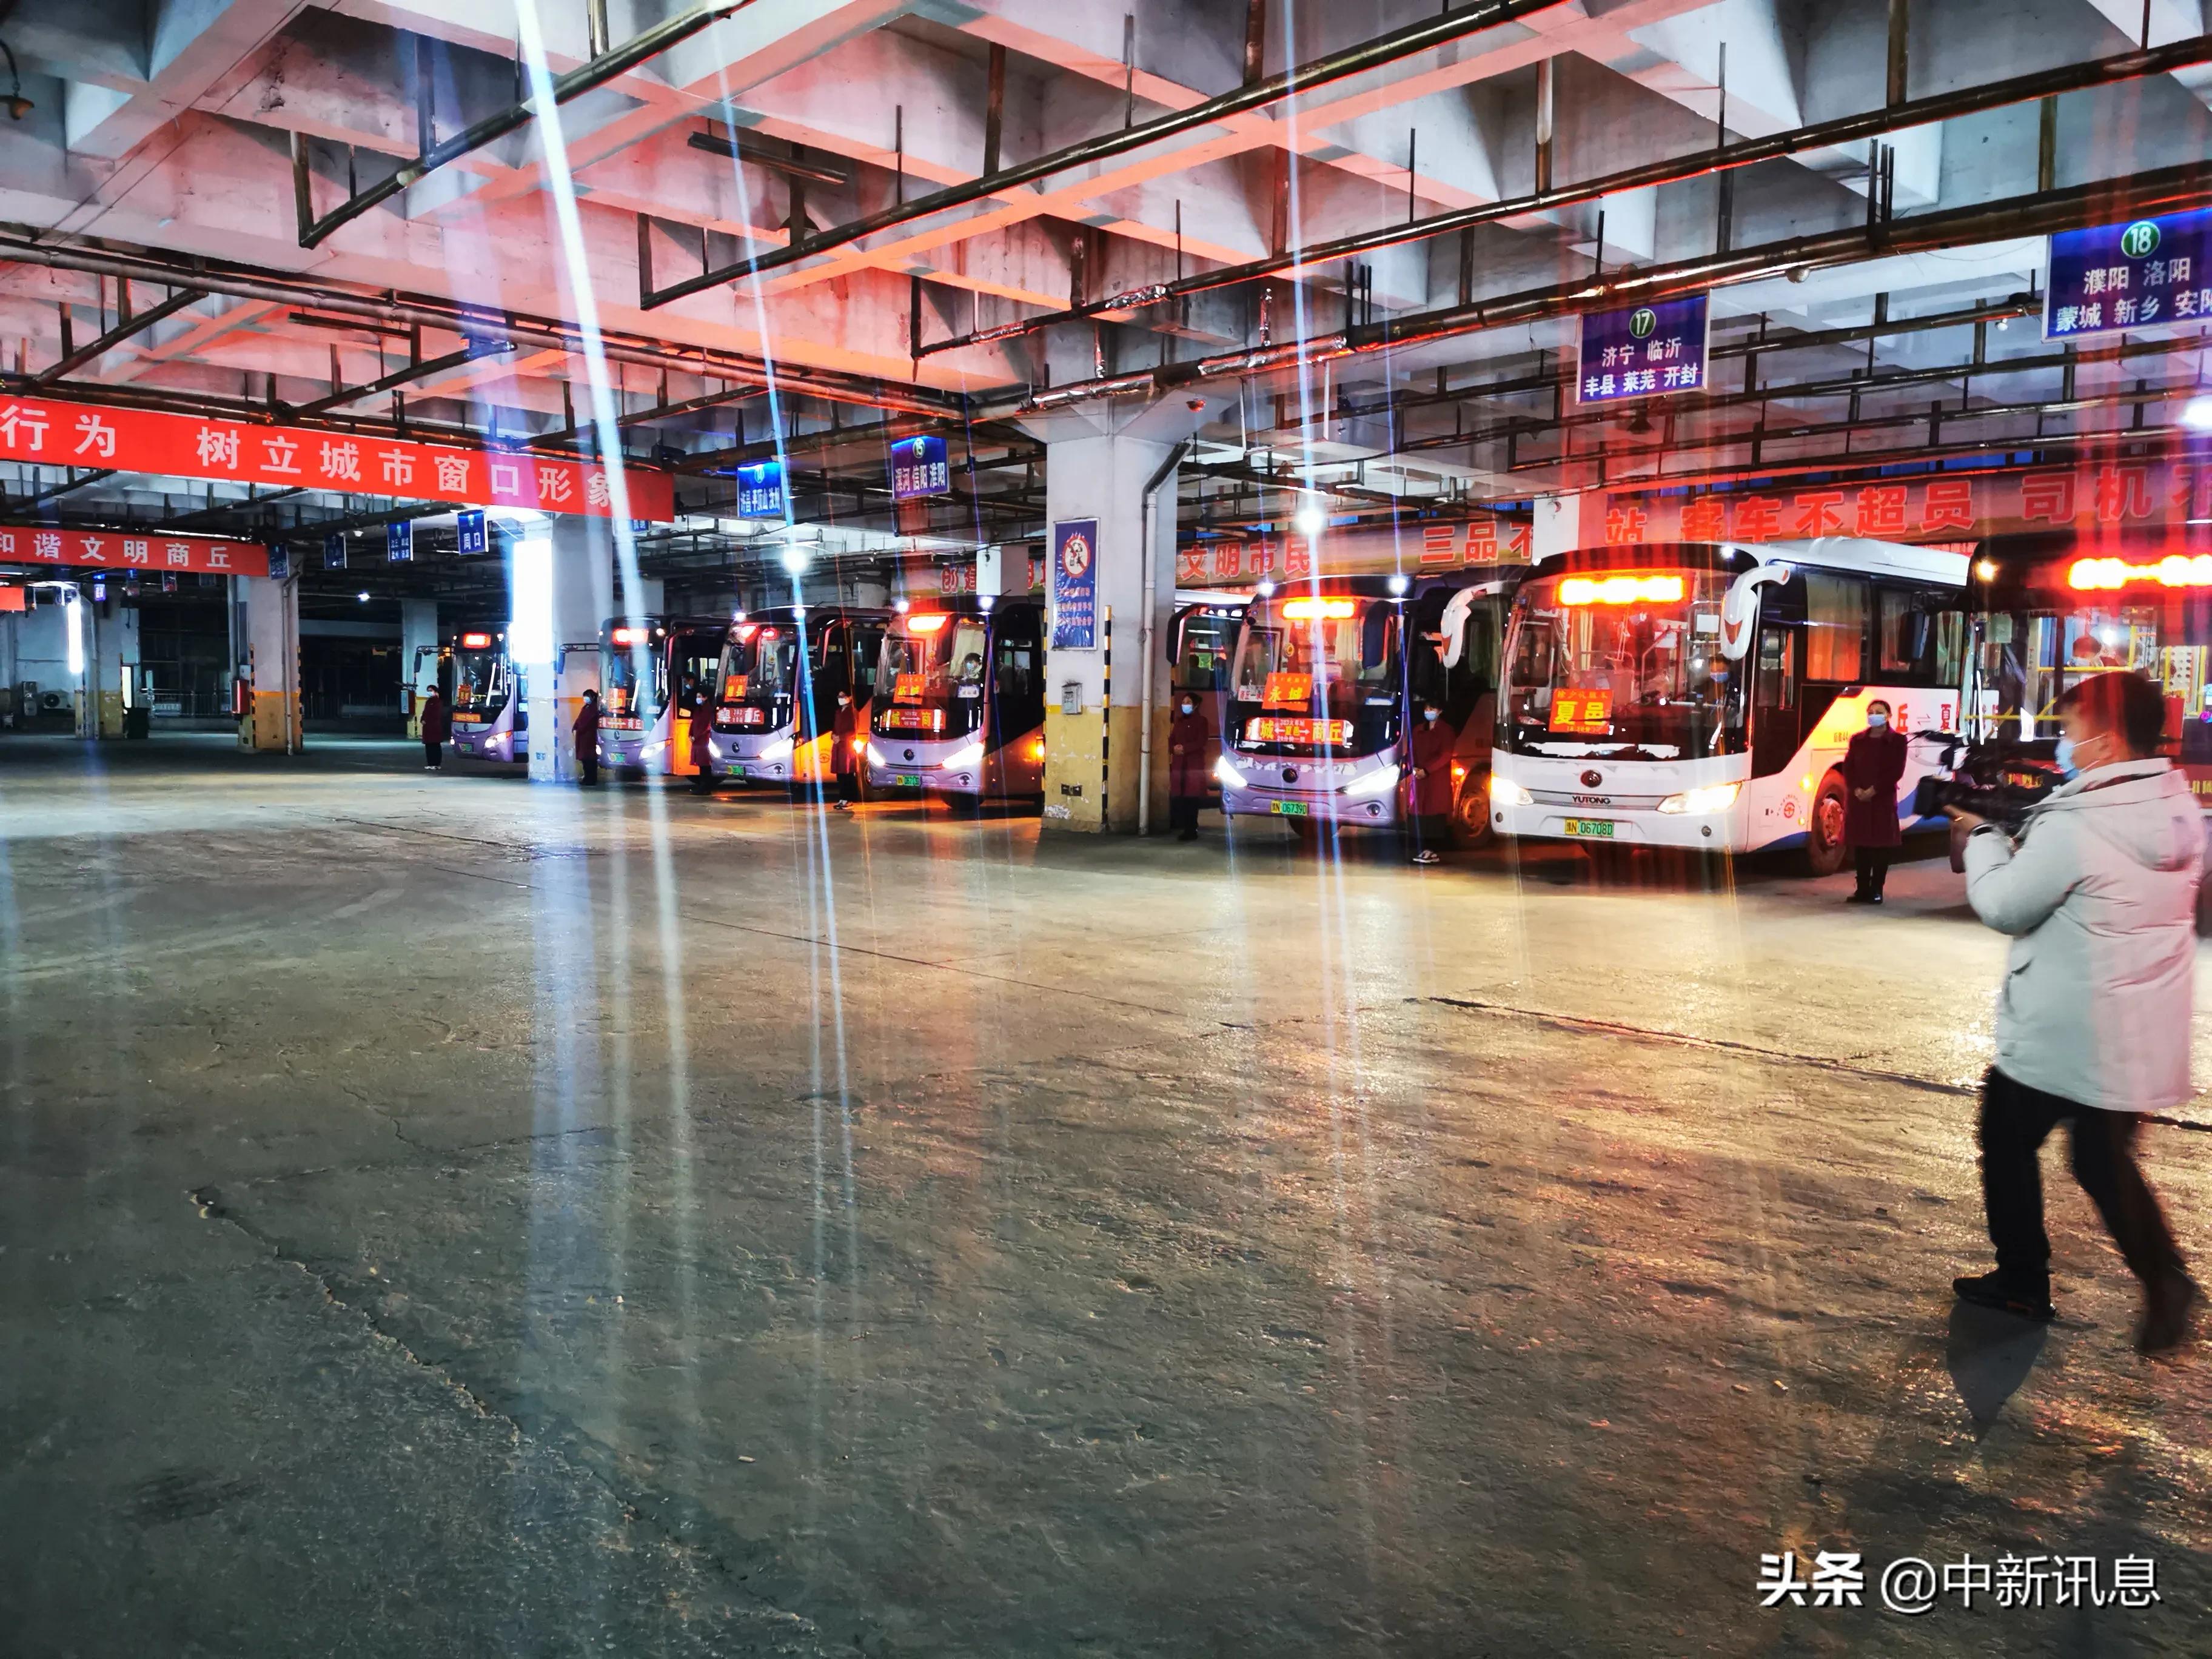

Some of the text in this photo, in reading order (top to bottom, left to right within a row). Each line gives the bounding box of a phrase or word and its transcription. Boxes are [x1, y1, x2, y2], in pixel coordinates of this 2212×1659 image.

[2130, 226, 2152, 254] 18
[2143, 256, 2191, 287] 洛阳
[1636, 312, 1651, 335] 17
[2056, 303, 2102, 332] 蒙城
[2114, 296, 2160, 324] 新乡
[1601, 337, 1682, 367] 济宁 临沂
[1584, 362, 1698, 397] 丰县 莱芜 开封
[0, 404, 612, 509] 行为 树立城市窗口形象
[1181, 537, 1310, 580] 文明市民
[1680, 480, 1975, 544] 客车不超员
[1553, 700, 1604, 726] 夏邑
[1572, 796, 1610, 805] YUTONG
[1580, 822, 1613, 835] 06708D
